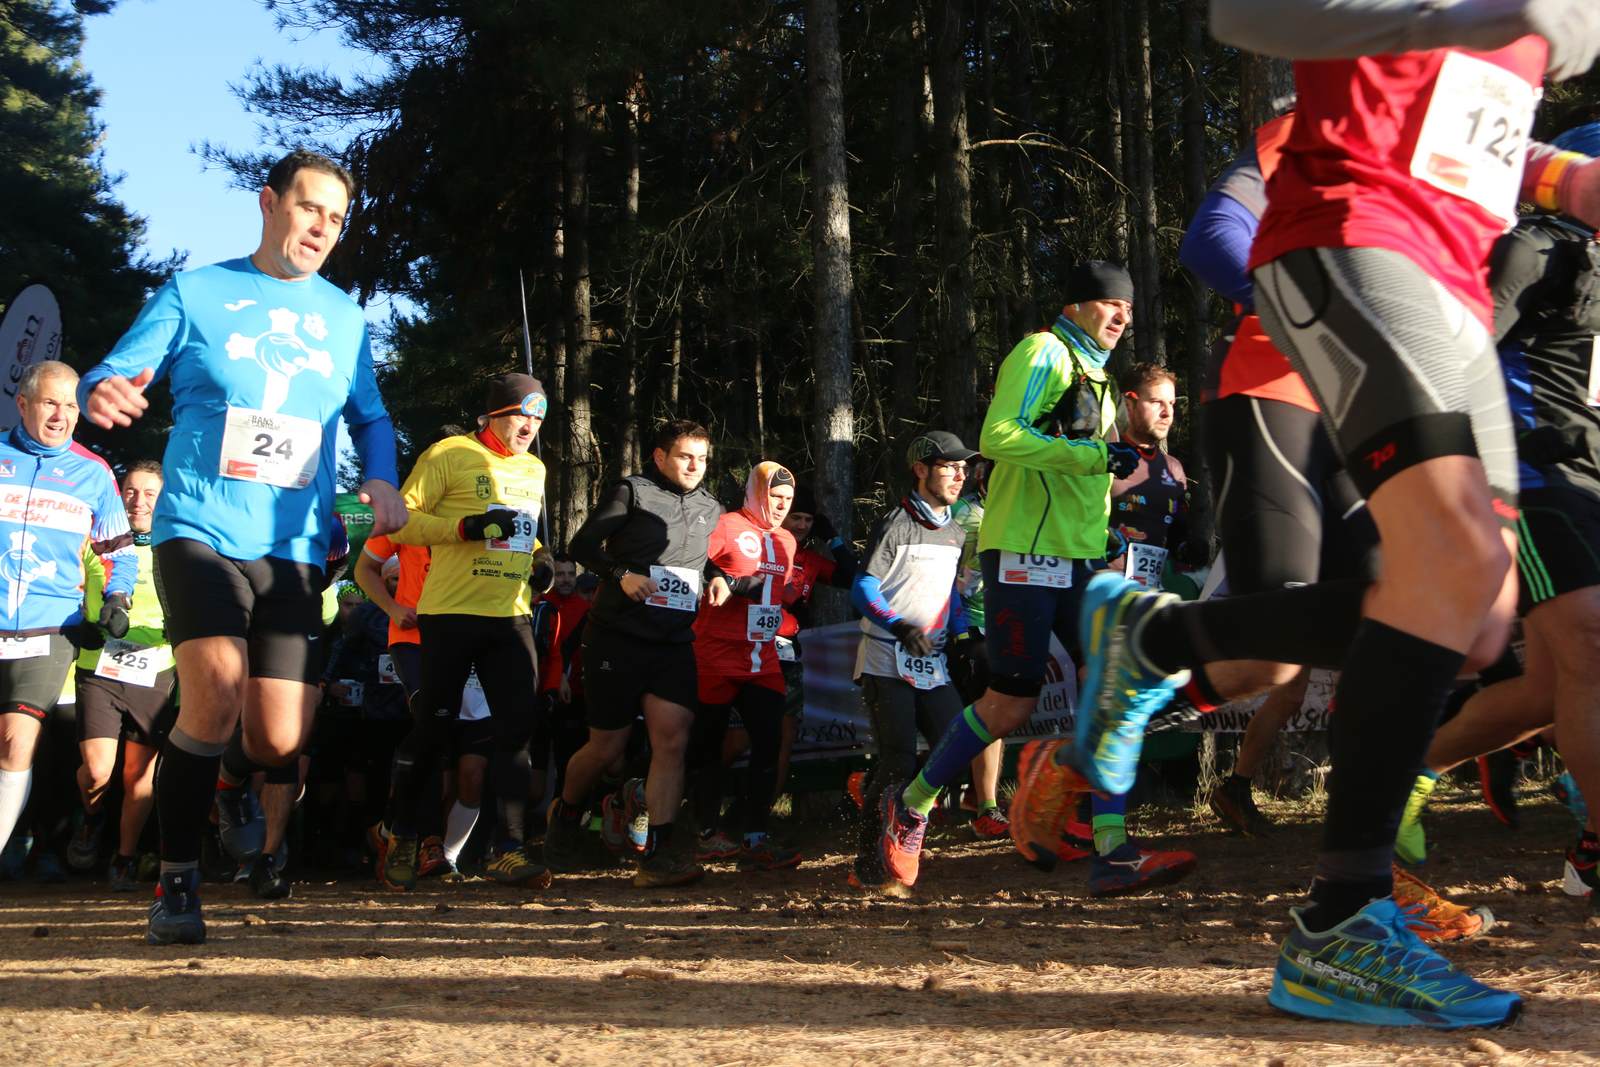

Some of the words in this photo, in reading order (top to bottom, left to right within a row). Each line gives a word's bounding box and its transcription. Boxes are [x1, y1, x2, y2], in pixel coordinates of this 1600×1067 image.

[1467, 107, 1521, 168] 122
[251, 433, 293, 460] 24
[1138, 557, 1162, 575] 256
[659, 578, 690, 595] 328
[756, 615, 780, 629] 489
[112, 651, 149, 671] 425
[904, 657, 935, 675] 495
[1043, 687, 1068, 712] del
